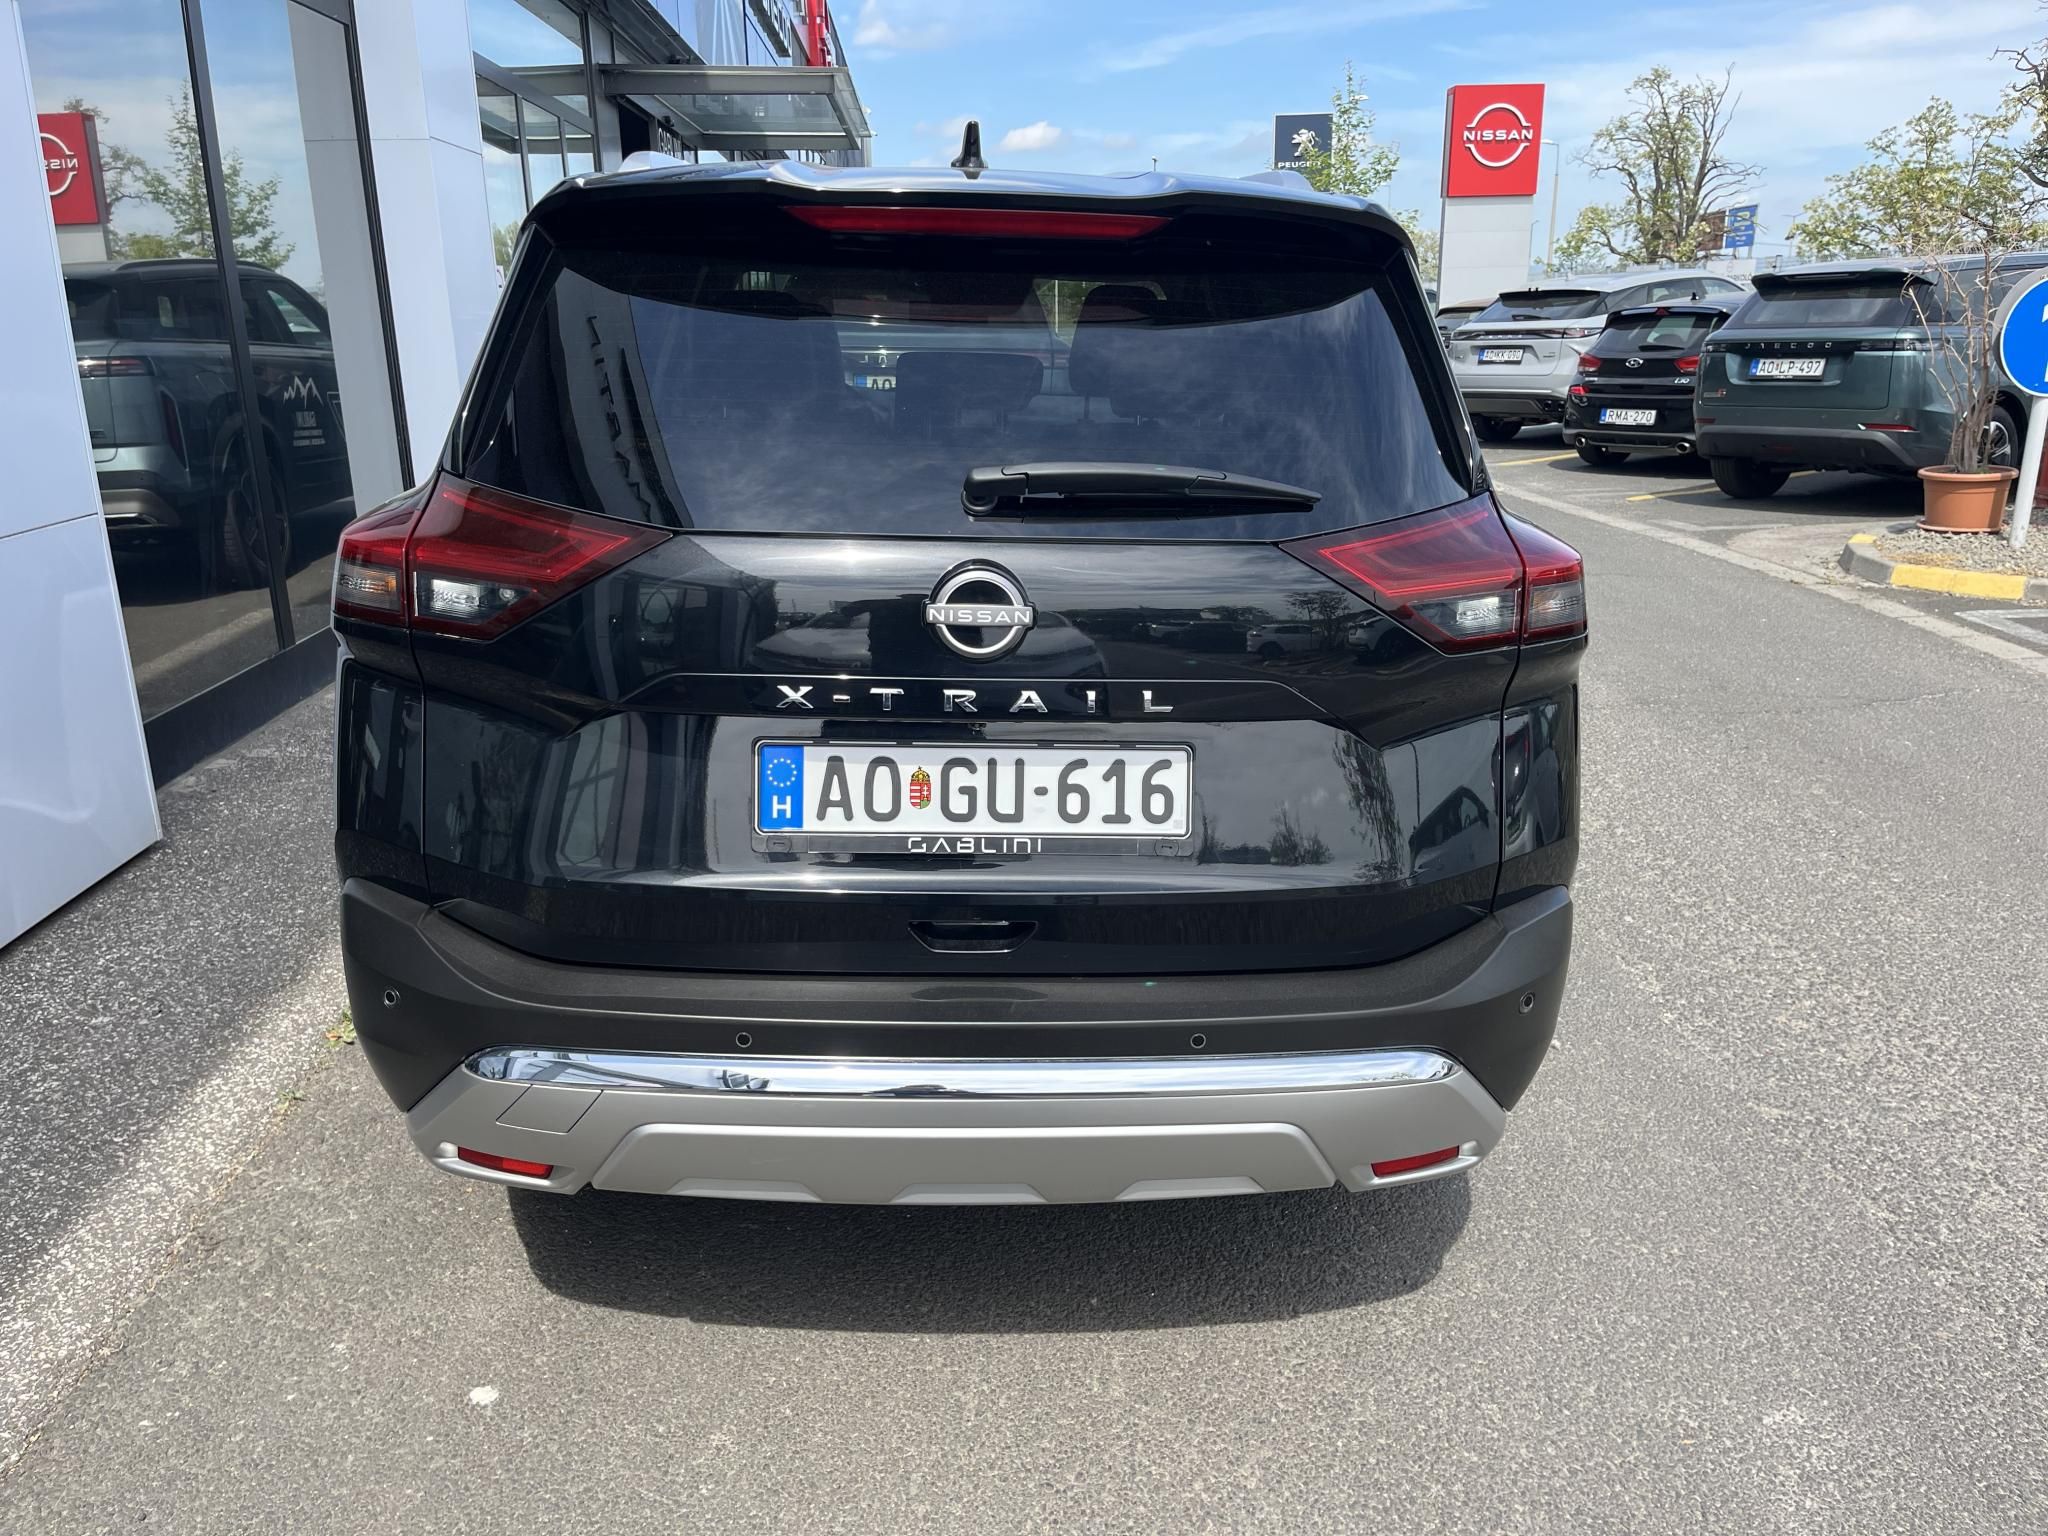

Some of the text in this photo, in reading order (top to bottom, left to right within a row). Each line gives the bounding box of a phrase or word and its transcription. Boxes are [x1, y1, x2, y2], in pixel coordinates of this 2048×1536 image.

[1463, 129, 1533, 141] NISSAN
[1608, 410, 1652, 422] RMA-270
[929, 608, 1031, 624] NISSAN
[777, 685, 1174, 714] X-TRAIL
[816, 755, 1175, 825] AO GU-616
[772, 795, 792, 819] H
[908, 837, 1043, 854] GABLINI
